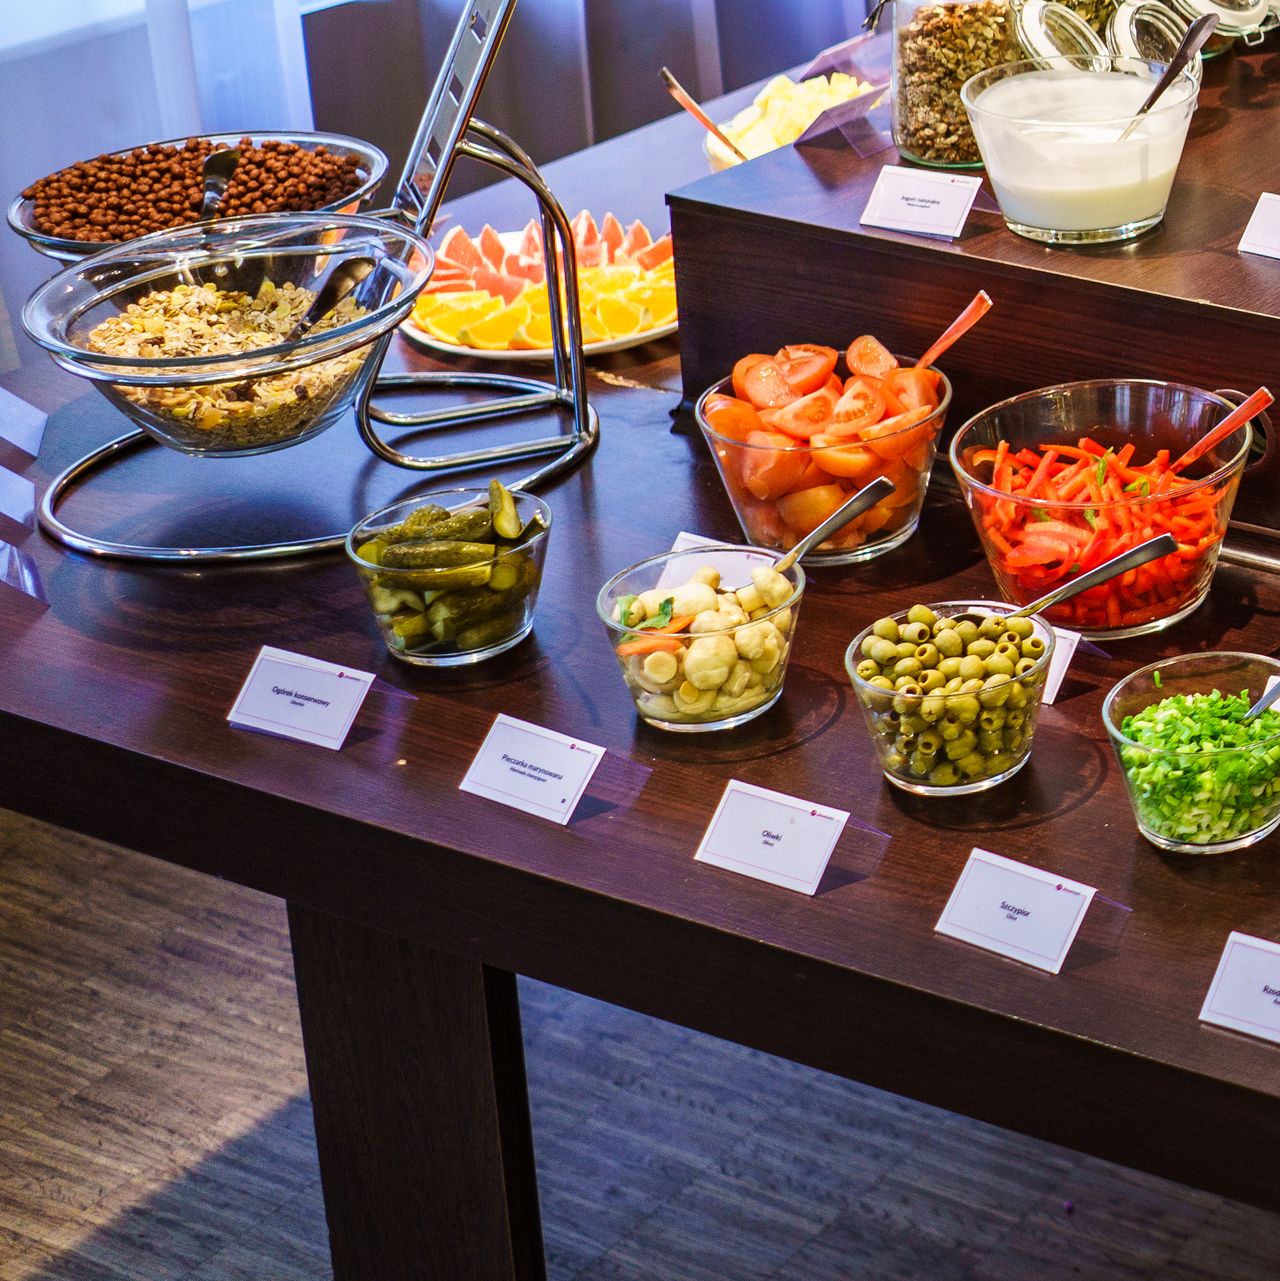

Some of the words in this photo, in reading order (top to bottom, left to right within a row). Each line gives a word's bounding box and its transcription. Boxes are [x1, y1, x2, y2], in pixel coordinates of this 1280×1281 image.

[271, 685, 293, 698] Ogórek
[293, 691, 331, 708] konserwowy
[501, 752, 528, 769] Pieczarka
[761, 828, 783, 842] Oliwki
[1000, 900, 1032, 918] Szczypior
